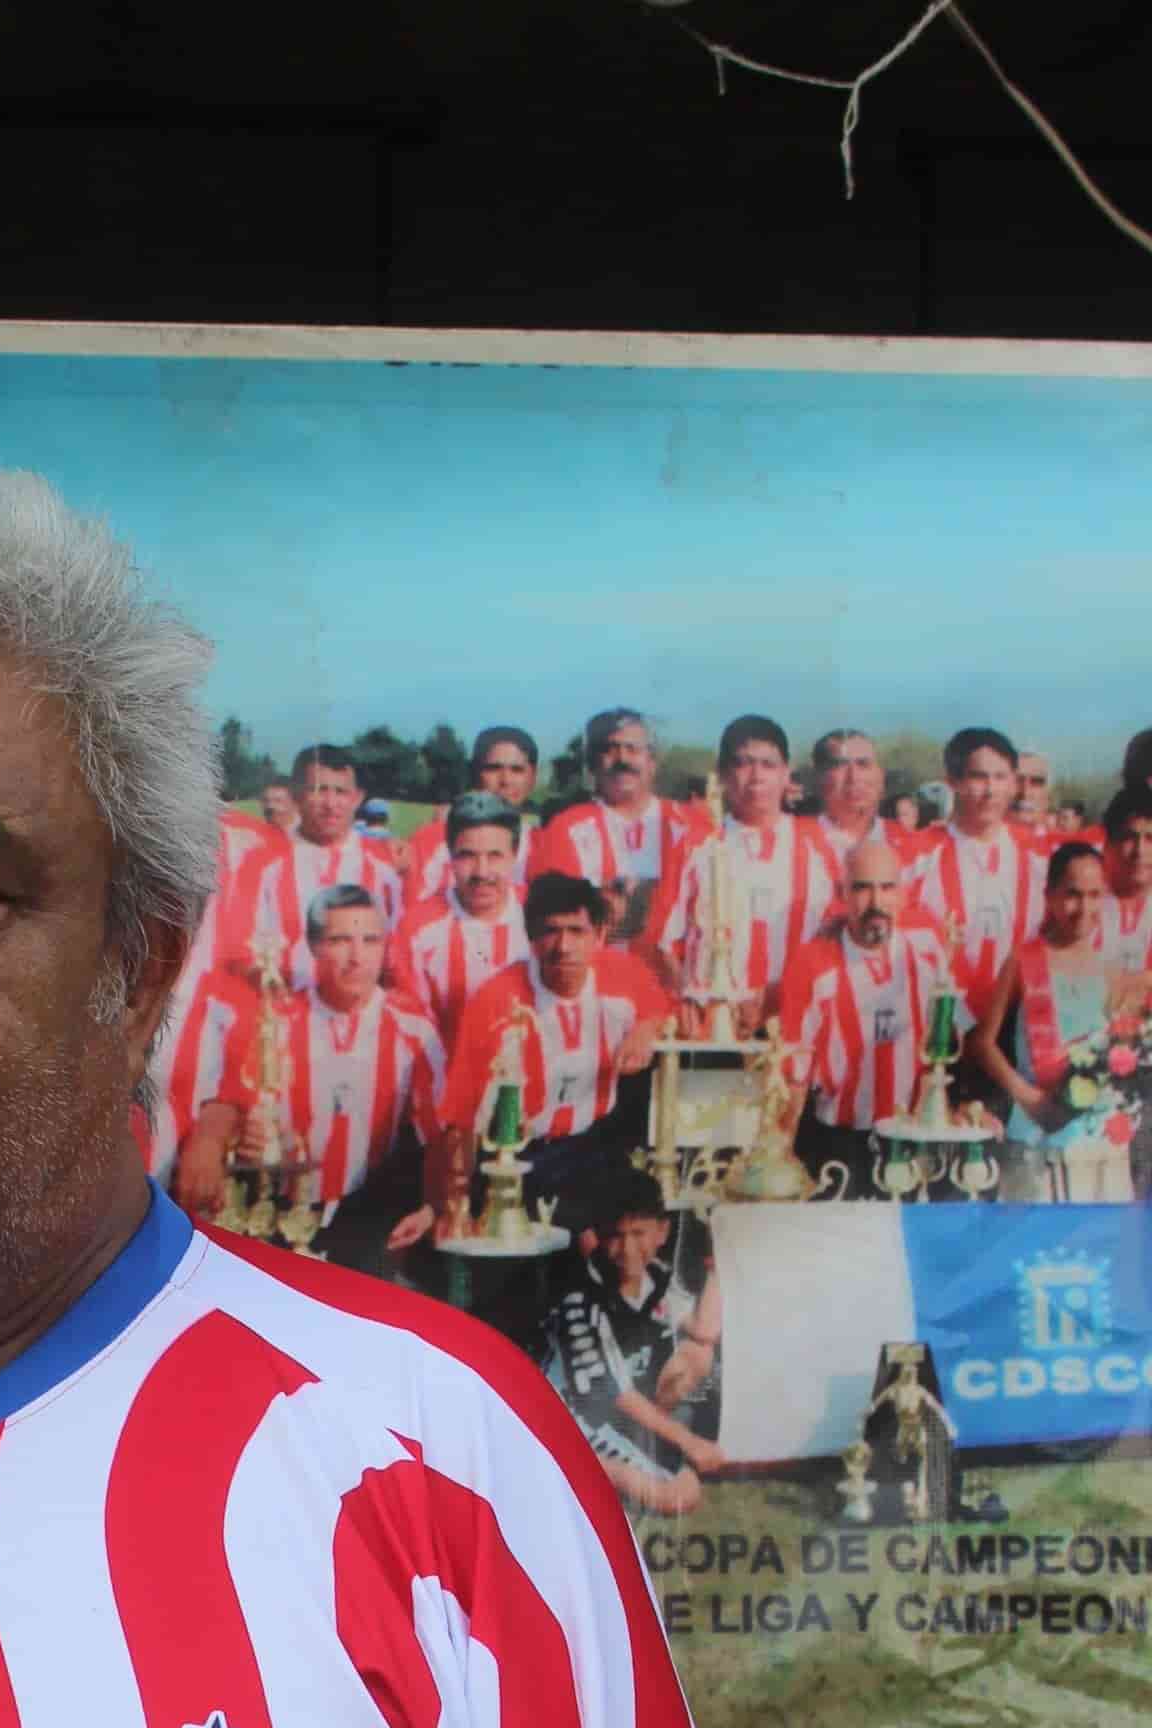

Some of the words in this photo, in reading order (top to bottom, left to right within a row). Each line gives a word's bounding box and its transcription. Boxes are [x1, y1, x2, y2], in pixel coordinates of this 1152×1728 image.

[952, 1354, 1152, 1400] CDSC
[643, 1534, 784, 1574] COPA
[801, 1535, 868, 1574] DE
[711, 1594, 831, 1633] LIGA
[843, 1594, 878, 1632] Y
